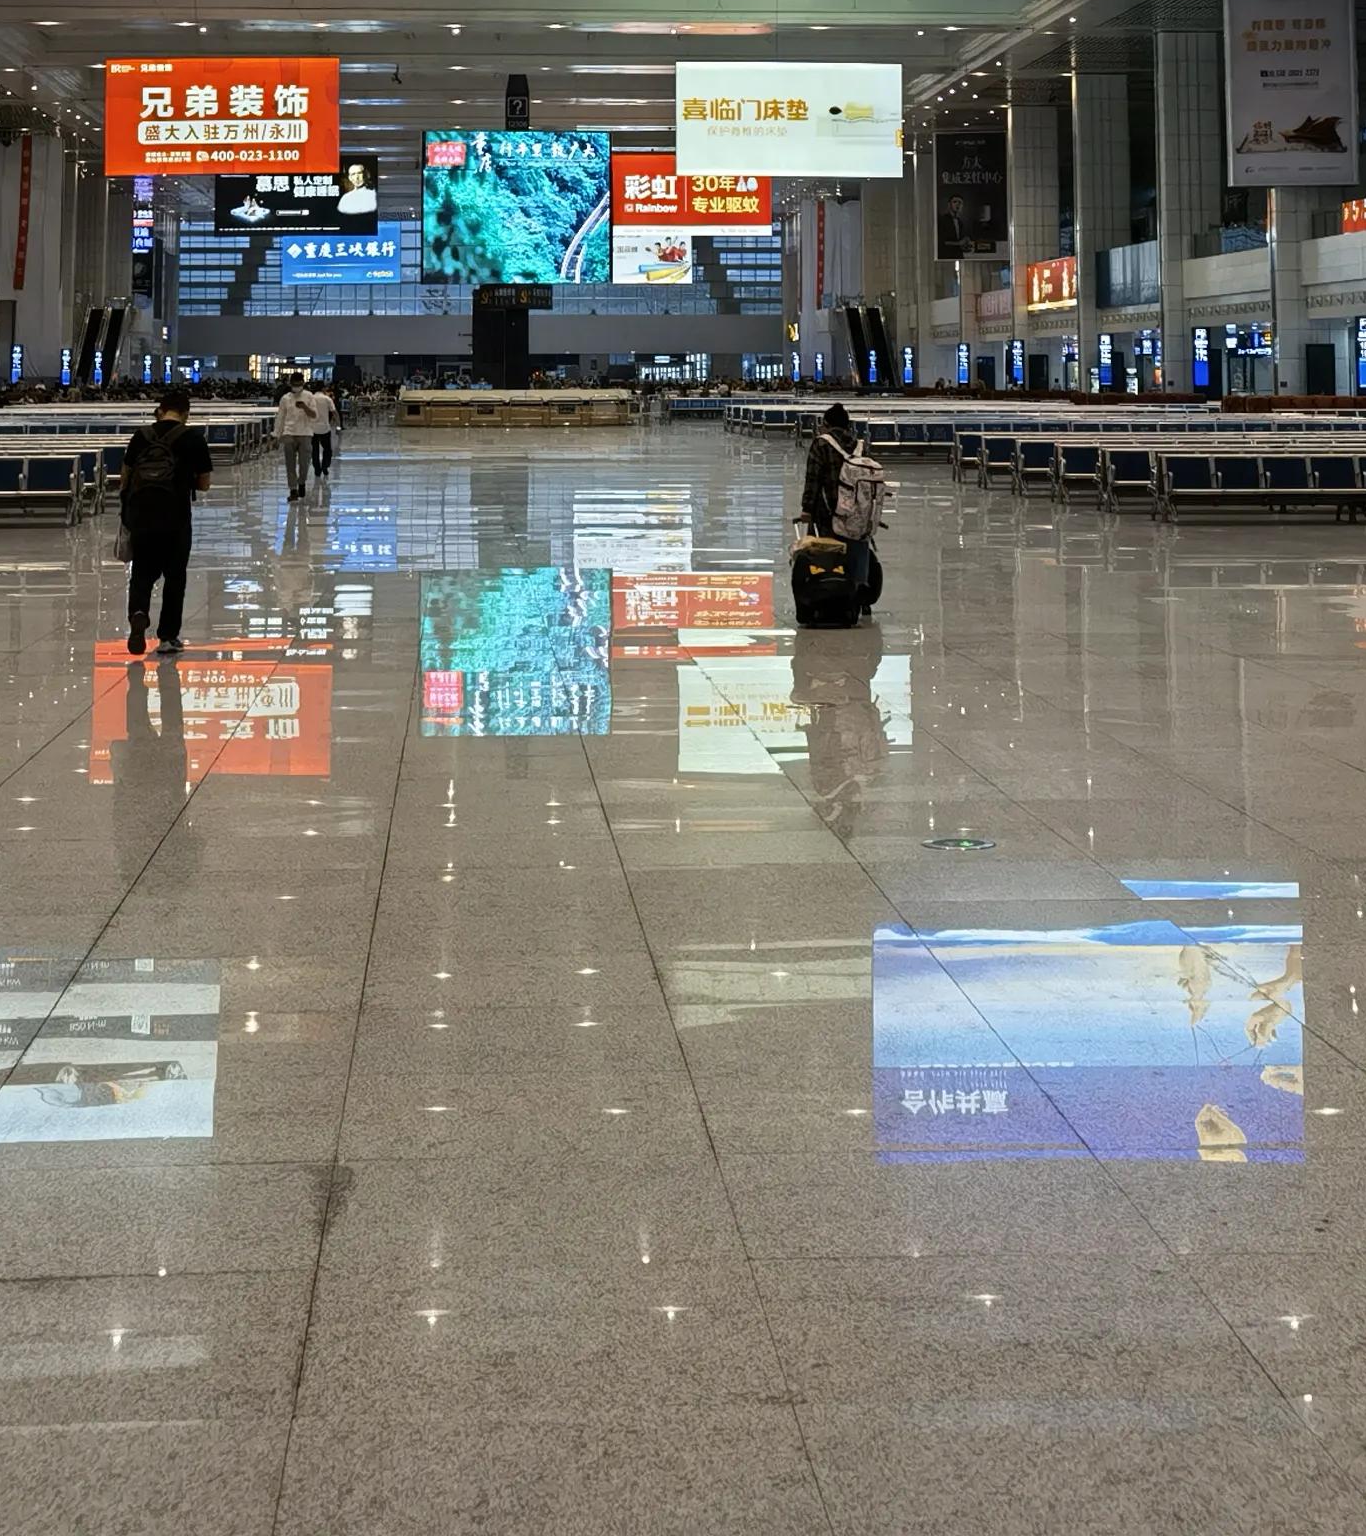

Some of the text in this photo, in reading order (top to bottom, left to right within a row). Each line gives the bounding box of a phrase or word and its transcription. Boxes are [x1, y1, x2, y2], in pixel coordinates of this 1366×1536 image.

[139, 84, 309, 118] 兄弟装饰
[682, 98, 809, 121] 喜临门床垫
[144, 123, 302, 141] 盛大入驻万州/永川
[210, 150, 299, 162] 400-023-1100
[255, 176, 290, 192] 慕思
[624, 174, 678, 200] 彩虹
[691, 176, 735, 192] 30年
[635, 204, 678, 213] Rainbow
[691, 196, 760, 213] 专业驱蚊
[304, 241, 396, 259] 重庆三峡银行
